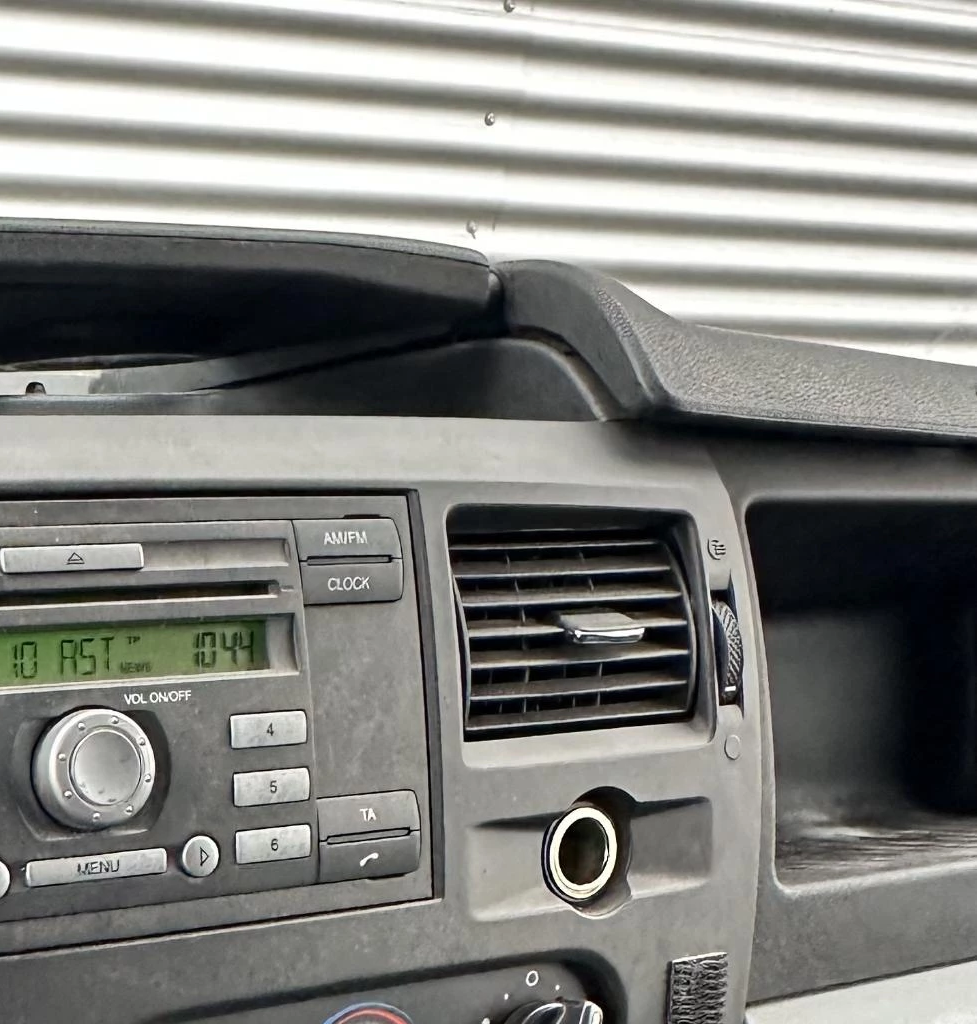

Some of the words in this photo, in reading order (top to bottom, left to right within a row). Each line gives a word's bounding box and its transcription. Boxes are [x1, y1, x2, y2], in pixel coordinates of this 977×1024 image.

[323, 530, 368, 545] AM/FM
[327, 575, 370, 591] CLOCK
[13, 641, 37, 679] 10
[124, 694, 148, 704] VOL
[150, 690, 192, 703] ON/OFF
[266, 723, 274, 736] 4
[269, 780, 278, 794] 5
[359, 808, 377, 821] TA
[270, 840, 279, 852] 6
[77, 859, 120, 875] MENU
